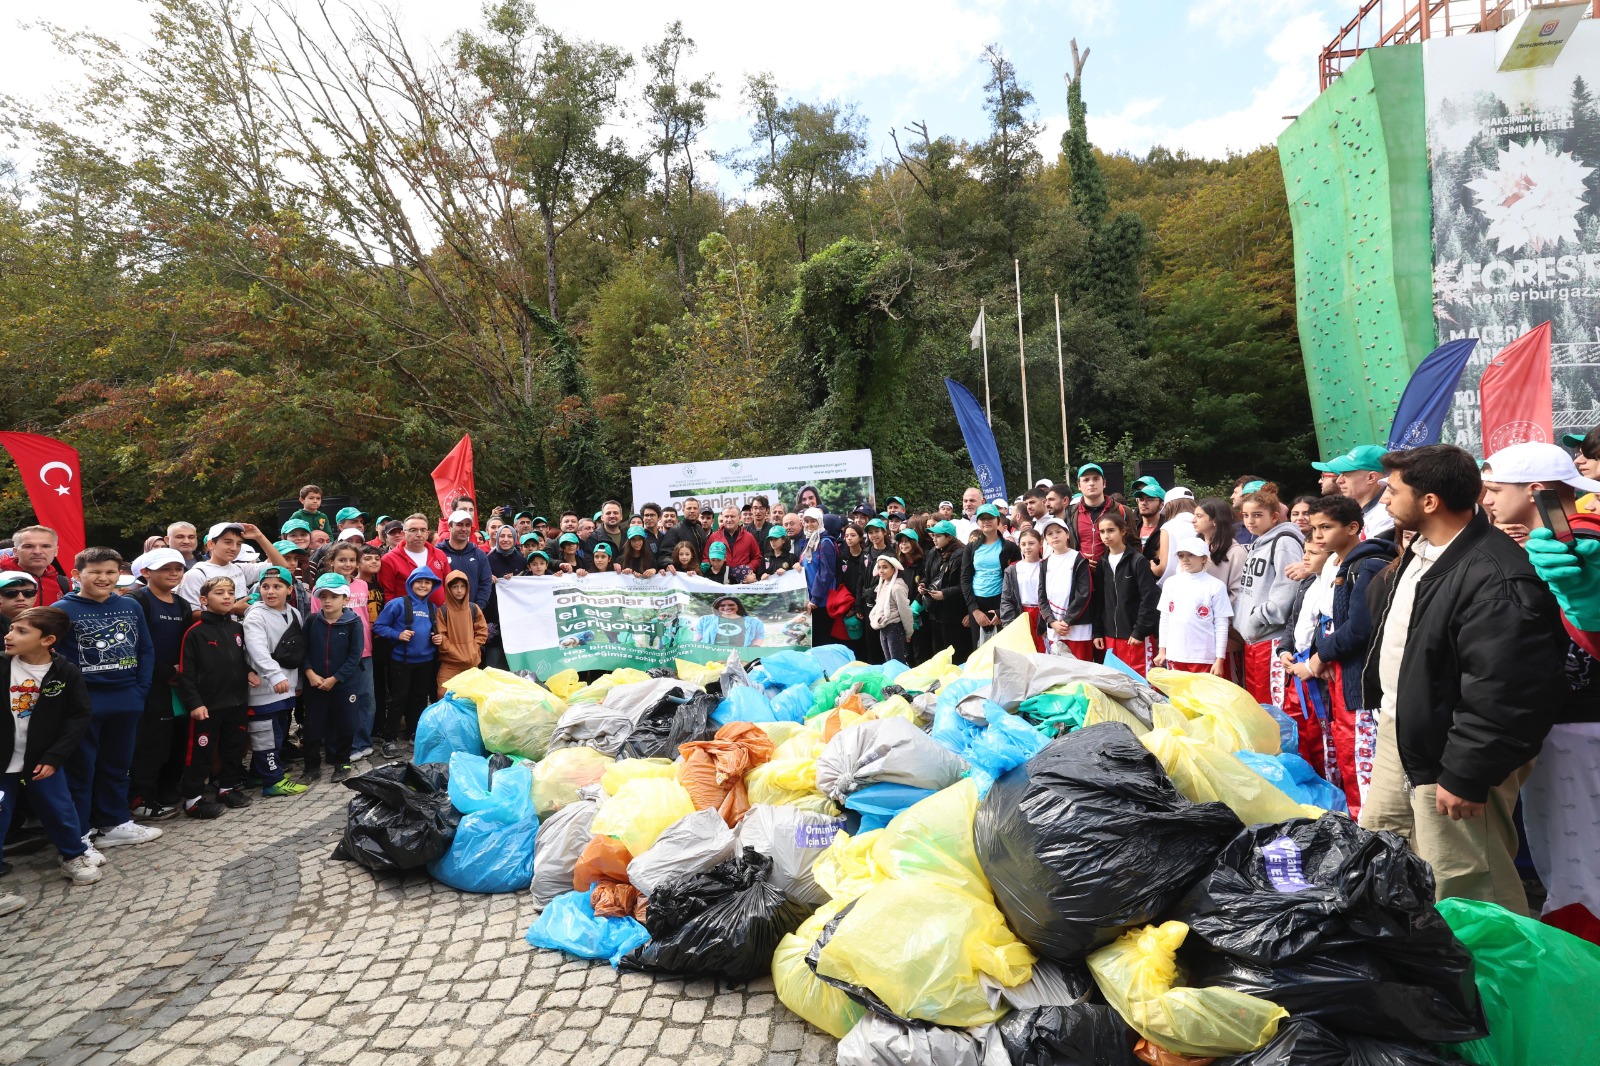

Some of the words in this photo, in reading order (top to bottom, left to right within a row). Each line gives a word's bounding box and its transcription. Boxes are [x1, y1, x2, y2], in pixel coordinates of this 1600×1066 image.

[1462, 253, 1600, 292] FOREST
[1472, 286, 1594, 305] kemerburgaz
[556, 595, 644, 606] ormanlar
[649, 595, 678, 608] için
[559, 608, 578, 620] el
[583, 608, 613, 619] ele
[560, 619, 656, 633] veriyoruz!
[563, 648, 586, 657] Hep
[563, 650, 633, 664] geleceğimize
[634, 655, 657, 664] sahip
[266, 752, 278, 771] BOSS
